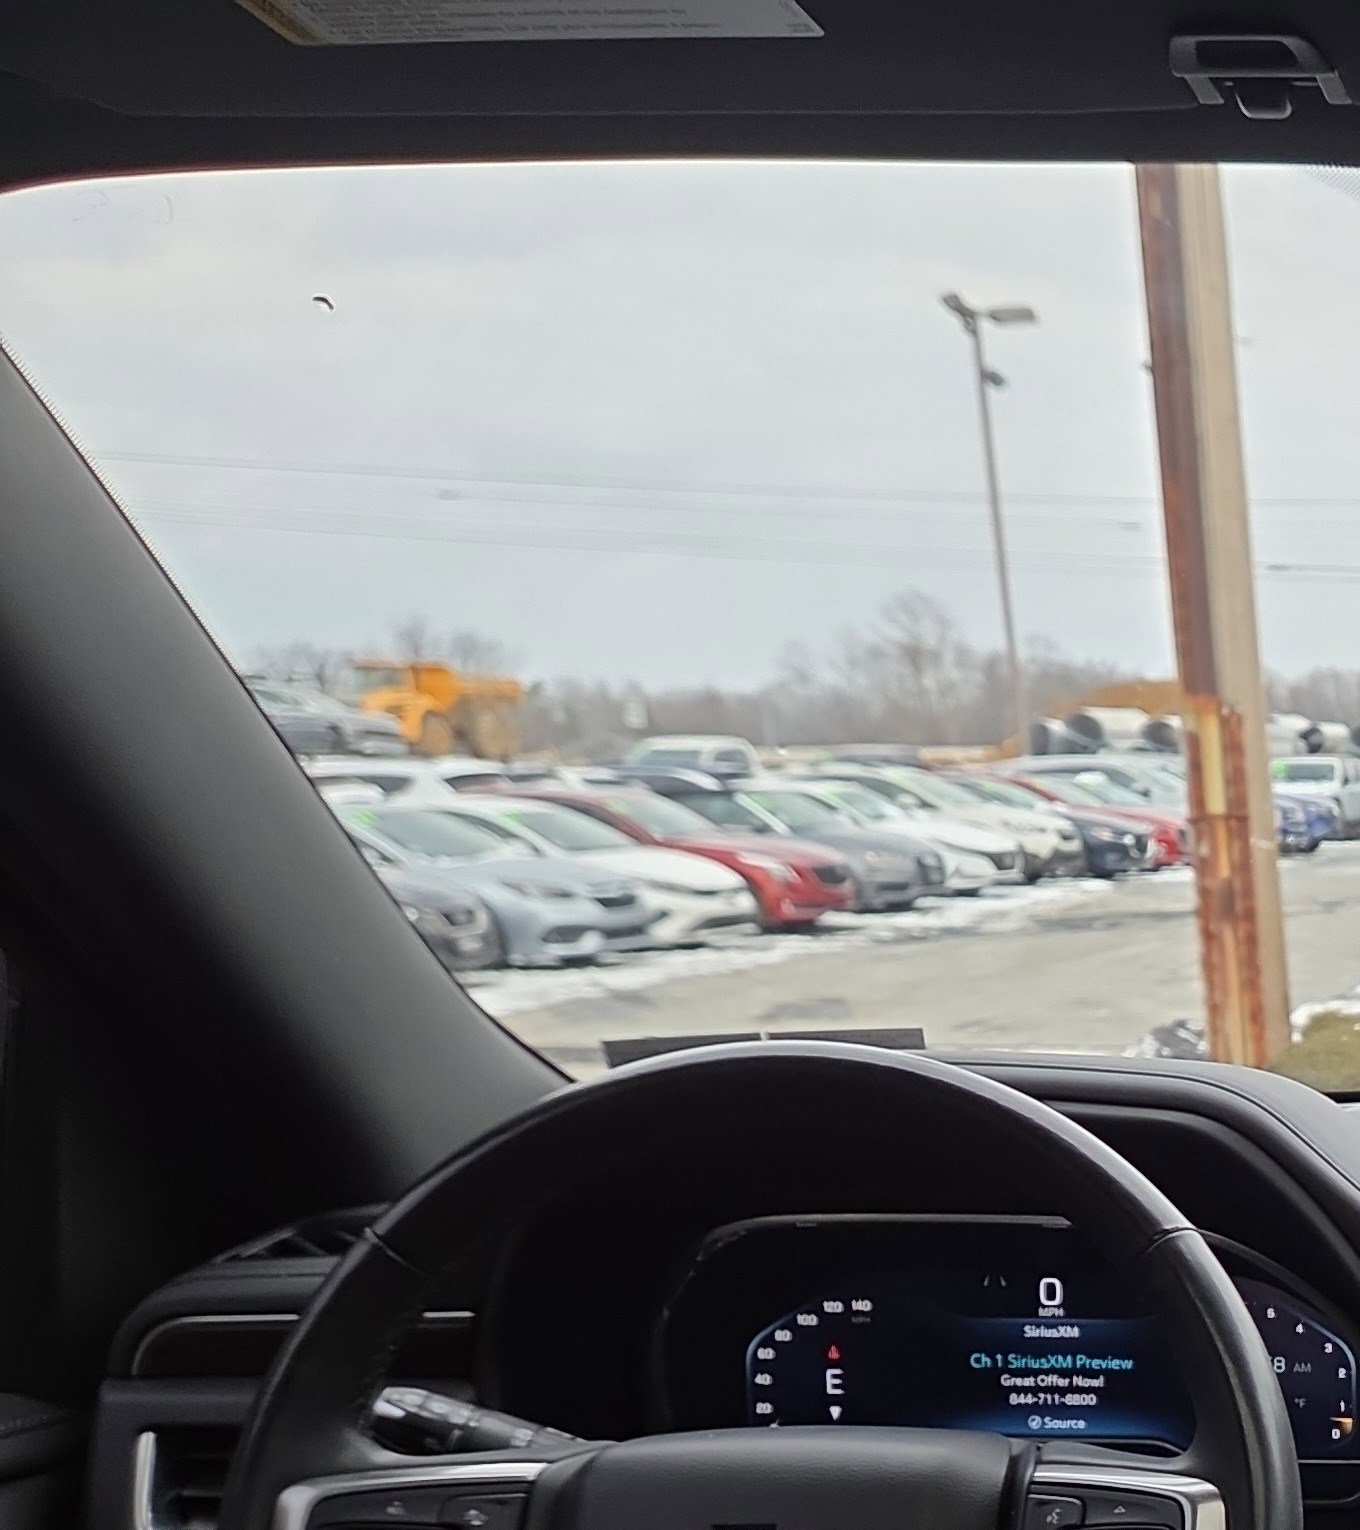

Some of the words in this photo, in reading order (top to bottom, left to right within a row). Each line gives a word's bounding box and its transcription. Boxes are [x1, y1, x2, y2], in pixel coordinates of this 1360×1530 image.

[1039, 1277, 1064, 1306] 0
[851, 1299, 873, 1312] 140
[1038, 1307, 1065, 1317] MPH
[1023, 1324, 1080, 1338] SiriusXM
[1295, 1323, 1304, 1334] 4
[1324, 1342, 1333, 1353] 3
[970, 1353, 991, 1369] Ch
[996, 1354, 1003, 1368] 1
[1008, 1354, 1073, 1369] SiriusXM
[1076, 1355, 1134, 1370] Preview
[1293, 1362, 1312, 1373] AM
[754, 1373, 773, 1385] 40
[1338, 1367, 1347, 1379] 2
[825, 1368, 845, 1394] E
[1000, 1373, 1036, 1387] Great
[1037, 1374, 1070, 1387] Offer
[1073, 1375, 1105, 1388] Now!
[1340, 1400, 1346, 1412] 1
[1043, 1416, 1087, 1429] Source
[1331, 1428, 1341, 1440] 0
